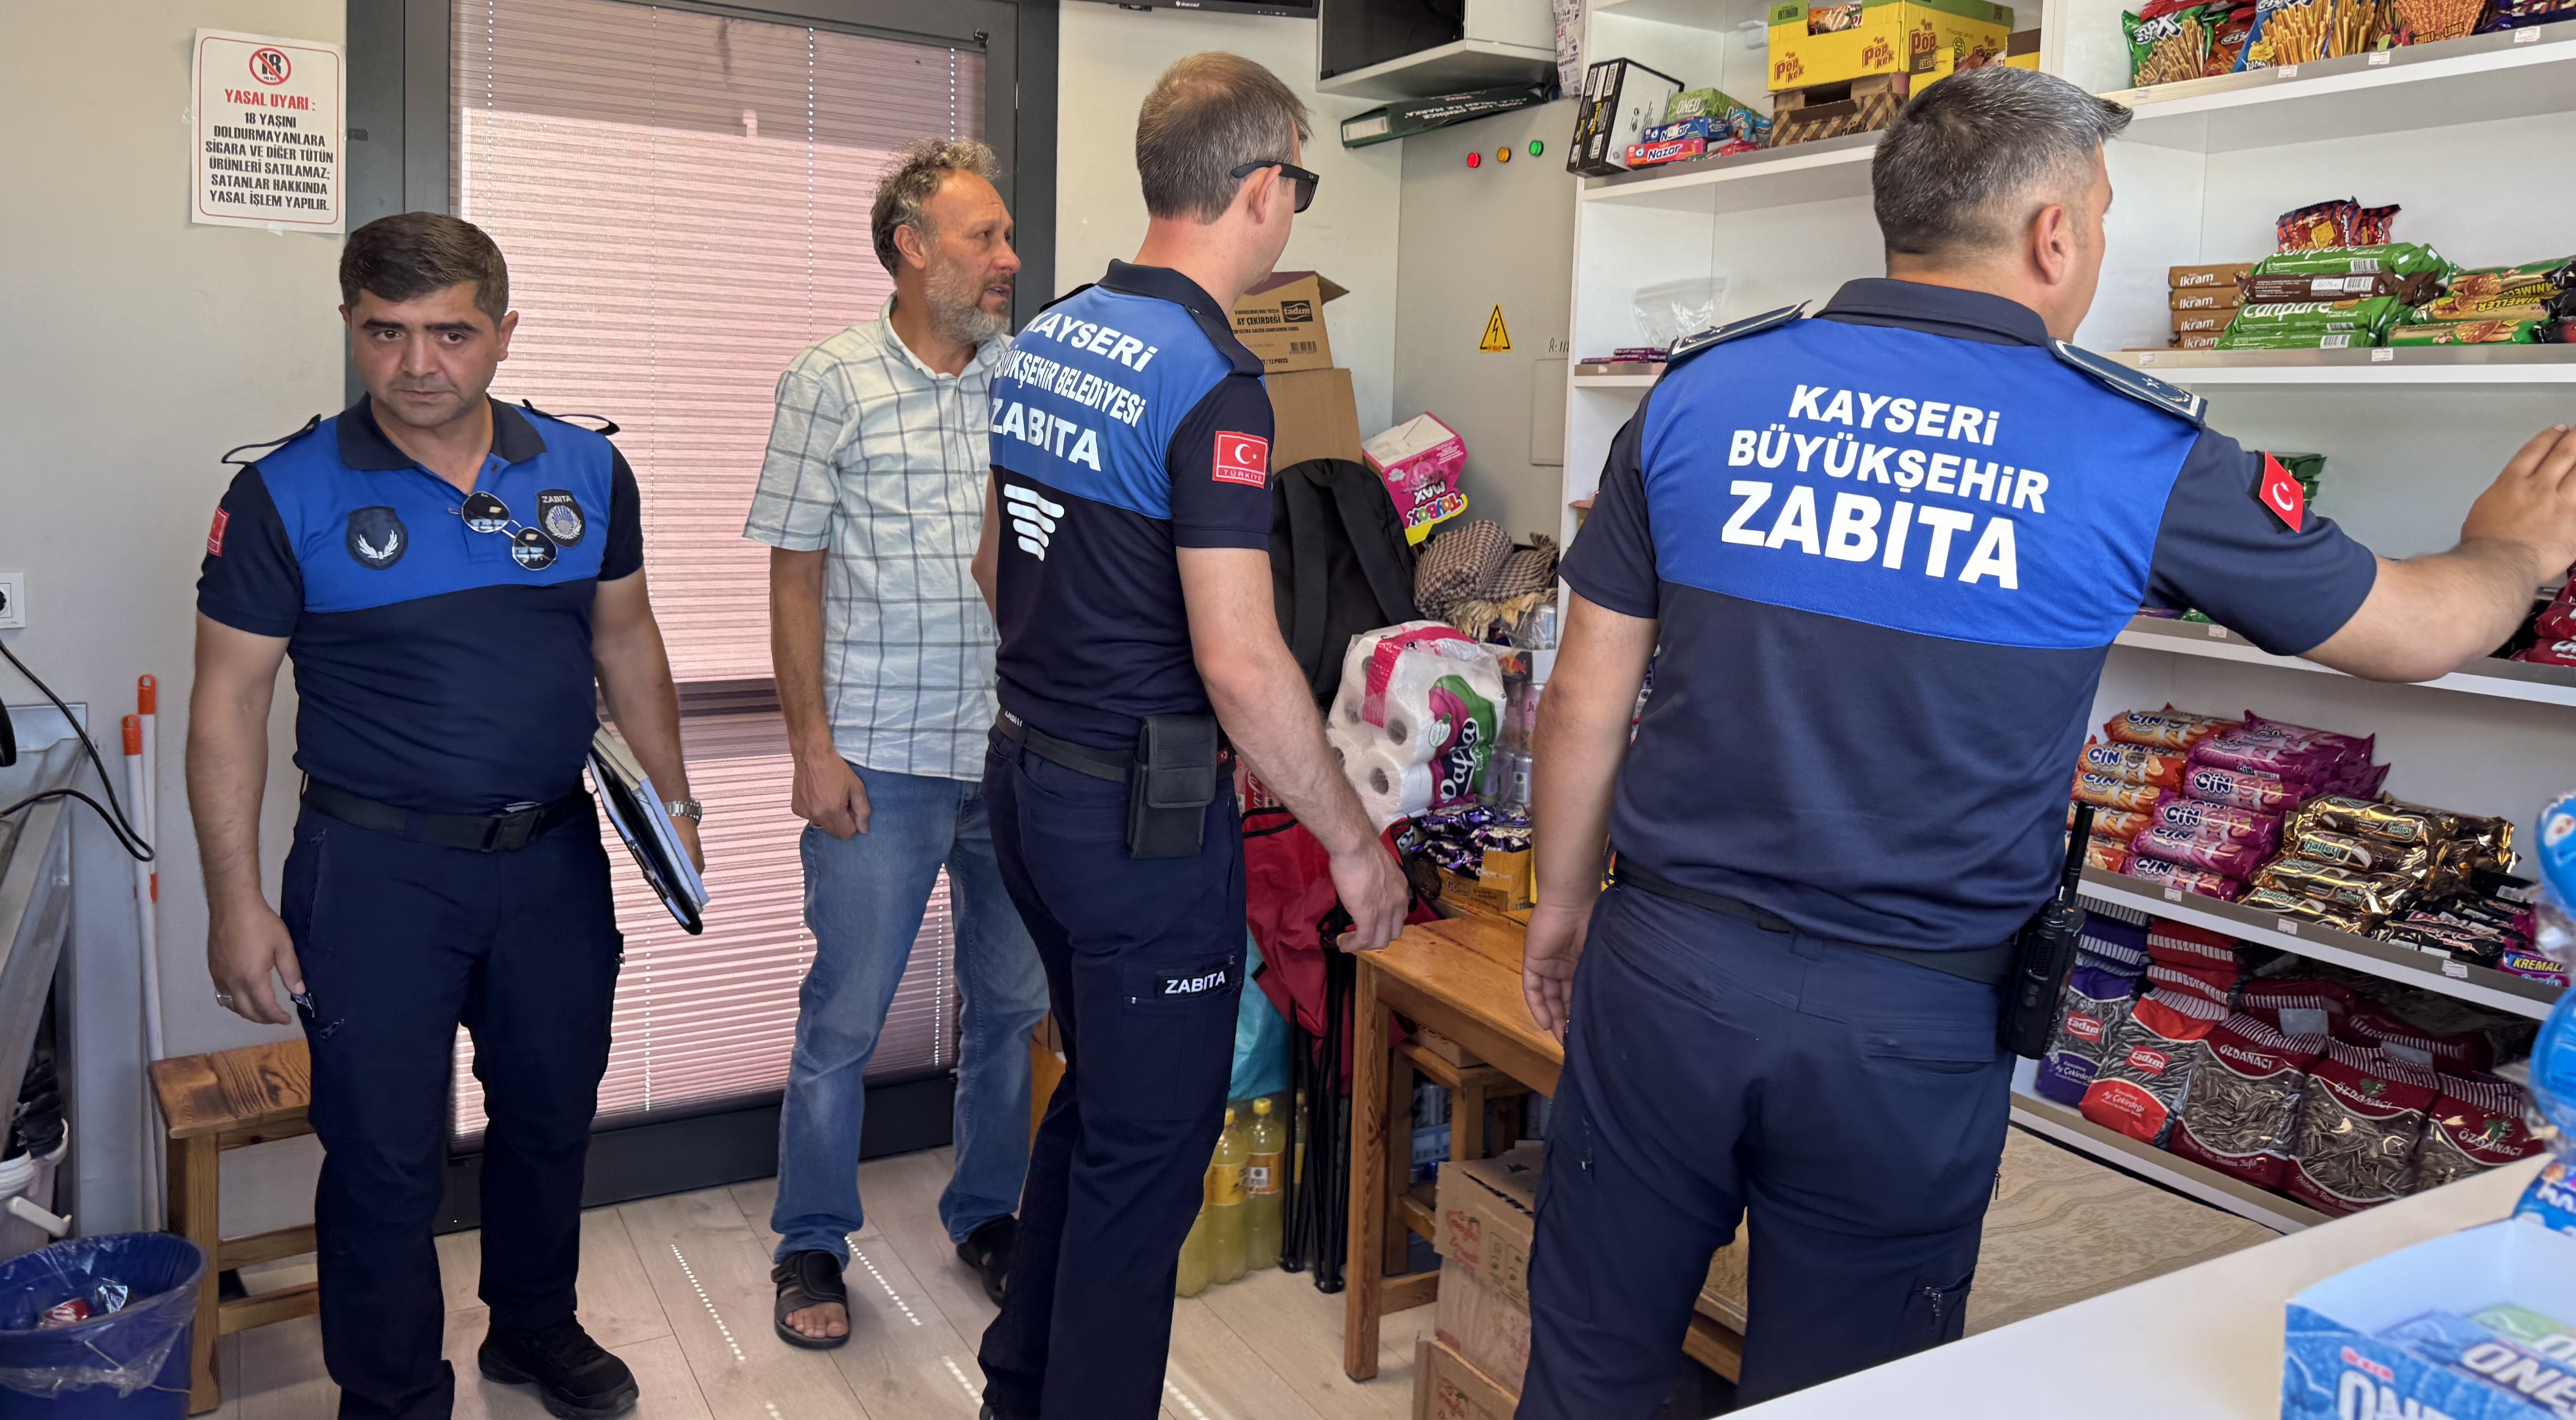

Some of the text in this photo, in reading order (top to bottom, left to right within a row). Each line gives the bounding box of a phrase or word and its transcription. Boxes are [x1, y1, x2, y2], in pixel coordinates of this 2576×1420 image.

[1863, 42, 1889, 68] Pop
[1775, 57, 1799, 82] Pop
[225, 88, 267, 106] YASAL
[271, 93, 308, 111] UYARI
[1676, 97, 1701, 114] ONEO
[245, 112, 296, 129] 18 YAŞINI
[1660, 123, 1691, 142] Nar
[214, 125, 326, 147] DOLDURMAYANLARA
[205, 138, 333, 163] SİGARA VE DİĞER TÜTÜN
[1647, 143, 1683, 161] Nazar
[209, 155, 330, 180] ÜRÜNLERİ SATILAMAZ;
[211, 174, 328, 195] SATANLAR HAKKINDA
[209, 189, 330, 211] YASAL İŞLEM YAPILIR.
[1022, 312, 1158, 372] KAYSERİ
[1054, 366, 1146, 427] BELEDİYESİ
[1789, 385, 2000, 446] KAYSERİ
[989, 397, 1102, 472] ZABITA
[1223, 469, 1262, 482] TÜRKİYE
[1728, 424, 2049, 513] BÜYÜKŞEHİR
[542, 495, 573, 503] ZABITA
[1414, 480, 1446, 505] MAX
[1407, 494, 1463, 526] TOYBOX
[1721, 480, 2018, 590] ZABITA
[1165, 971, 1225, 994] ZABITA
[2131, 1051, 2164, 1069] tadım
[2219, 1044, 2272, 1070] ÖZDANACI
[2462, 1342, 2576, 1411] ONE
